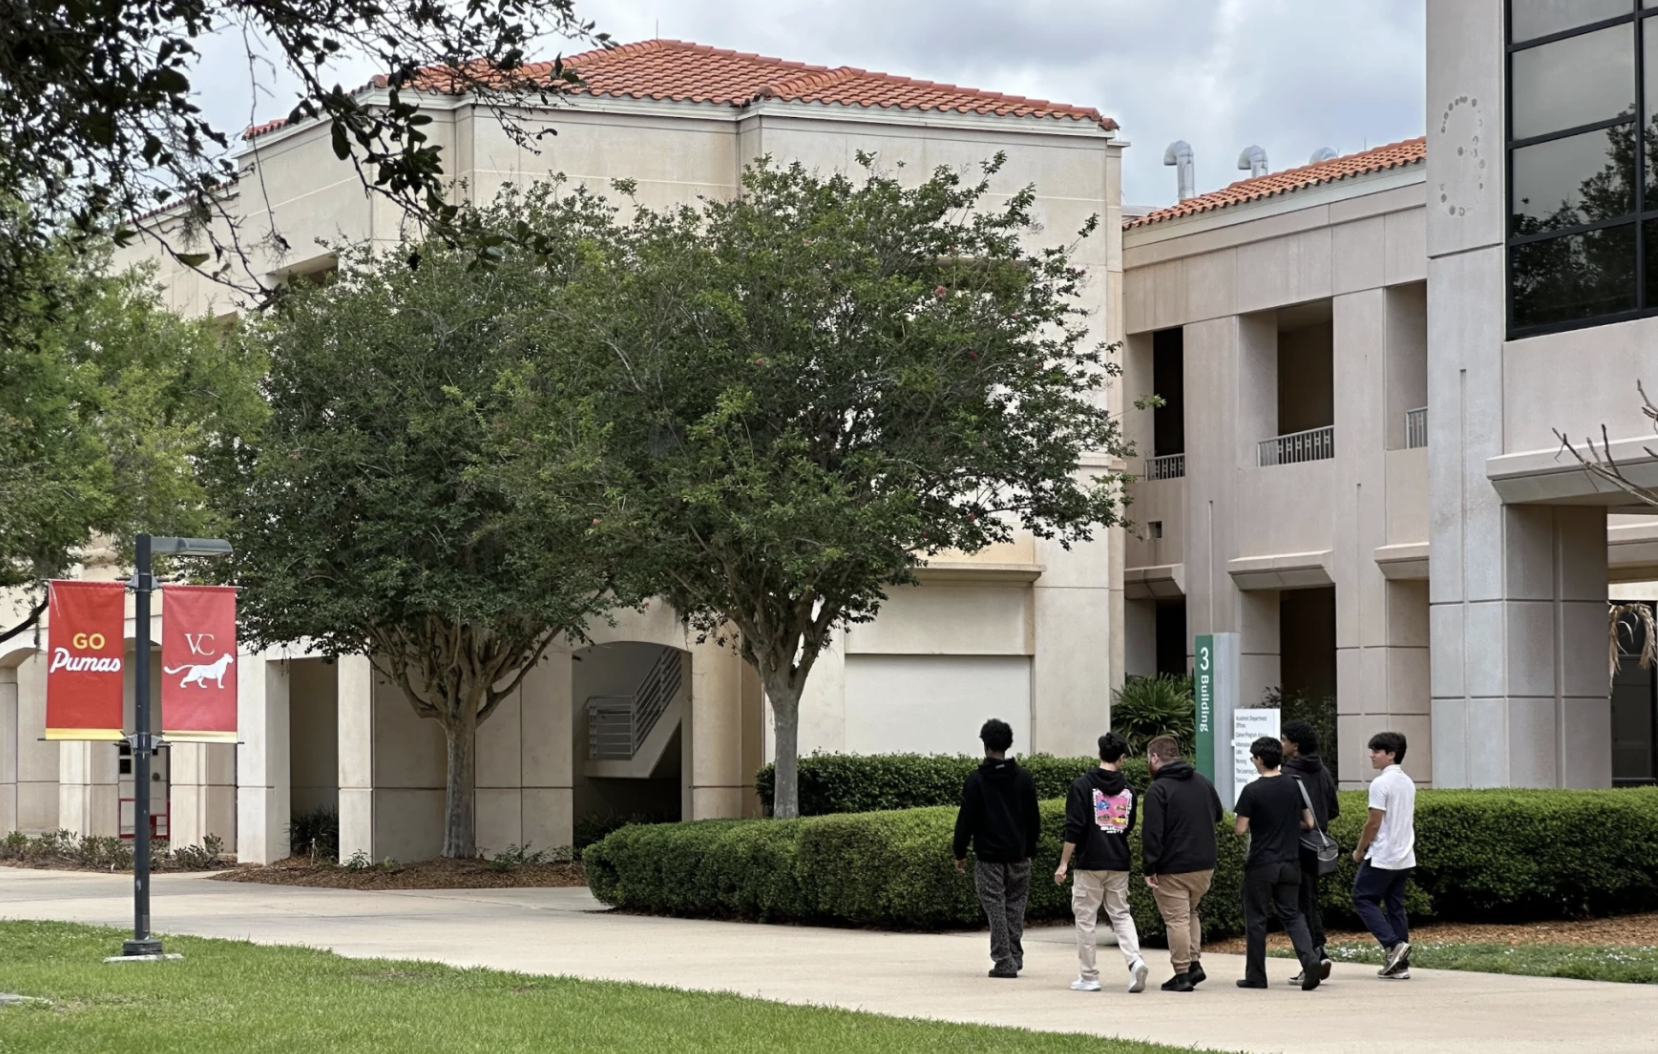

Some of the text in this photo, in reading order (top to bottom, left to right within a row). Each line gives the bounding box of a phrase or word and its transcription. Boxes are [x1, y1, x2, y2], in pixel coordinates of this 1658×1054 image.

[72, 632, 106, 650] GO
[185, 633, 215, 656] VC
[49, 647, 121, 673] Pumas
[1199, 646, 1209, 733] 3 Building
